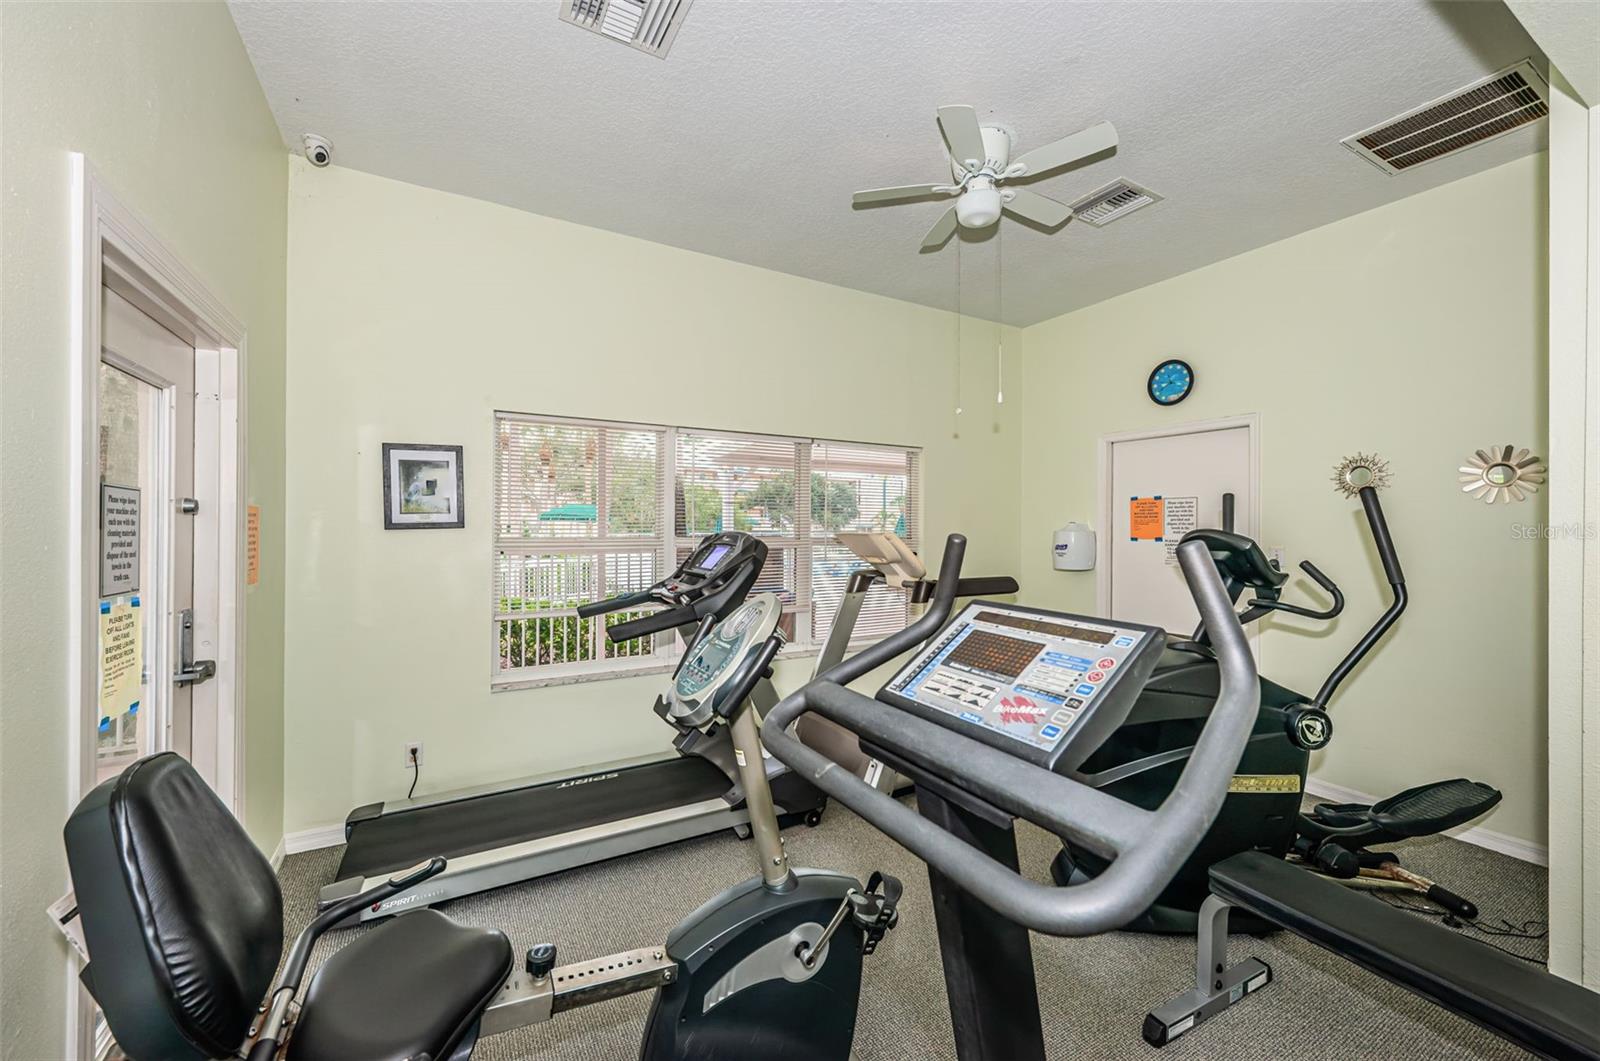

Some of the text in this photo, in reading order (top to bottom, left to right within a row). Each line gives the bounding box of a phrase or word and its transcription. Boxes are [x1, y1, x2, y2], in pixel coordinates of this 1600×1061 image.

[108, 495, 118, 503] Please
[105, 643, 122, 655] BEFORE
[992, 704, 1048, 715] BikeMax
[556, 773, 618, 789] SPIRIT
[382, 894, 417, 909] SPIRIT
